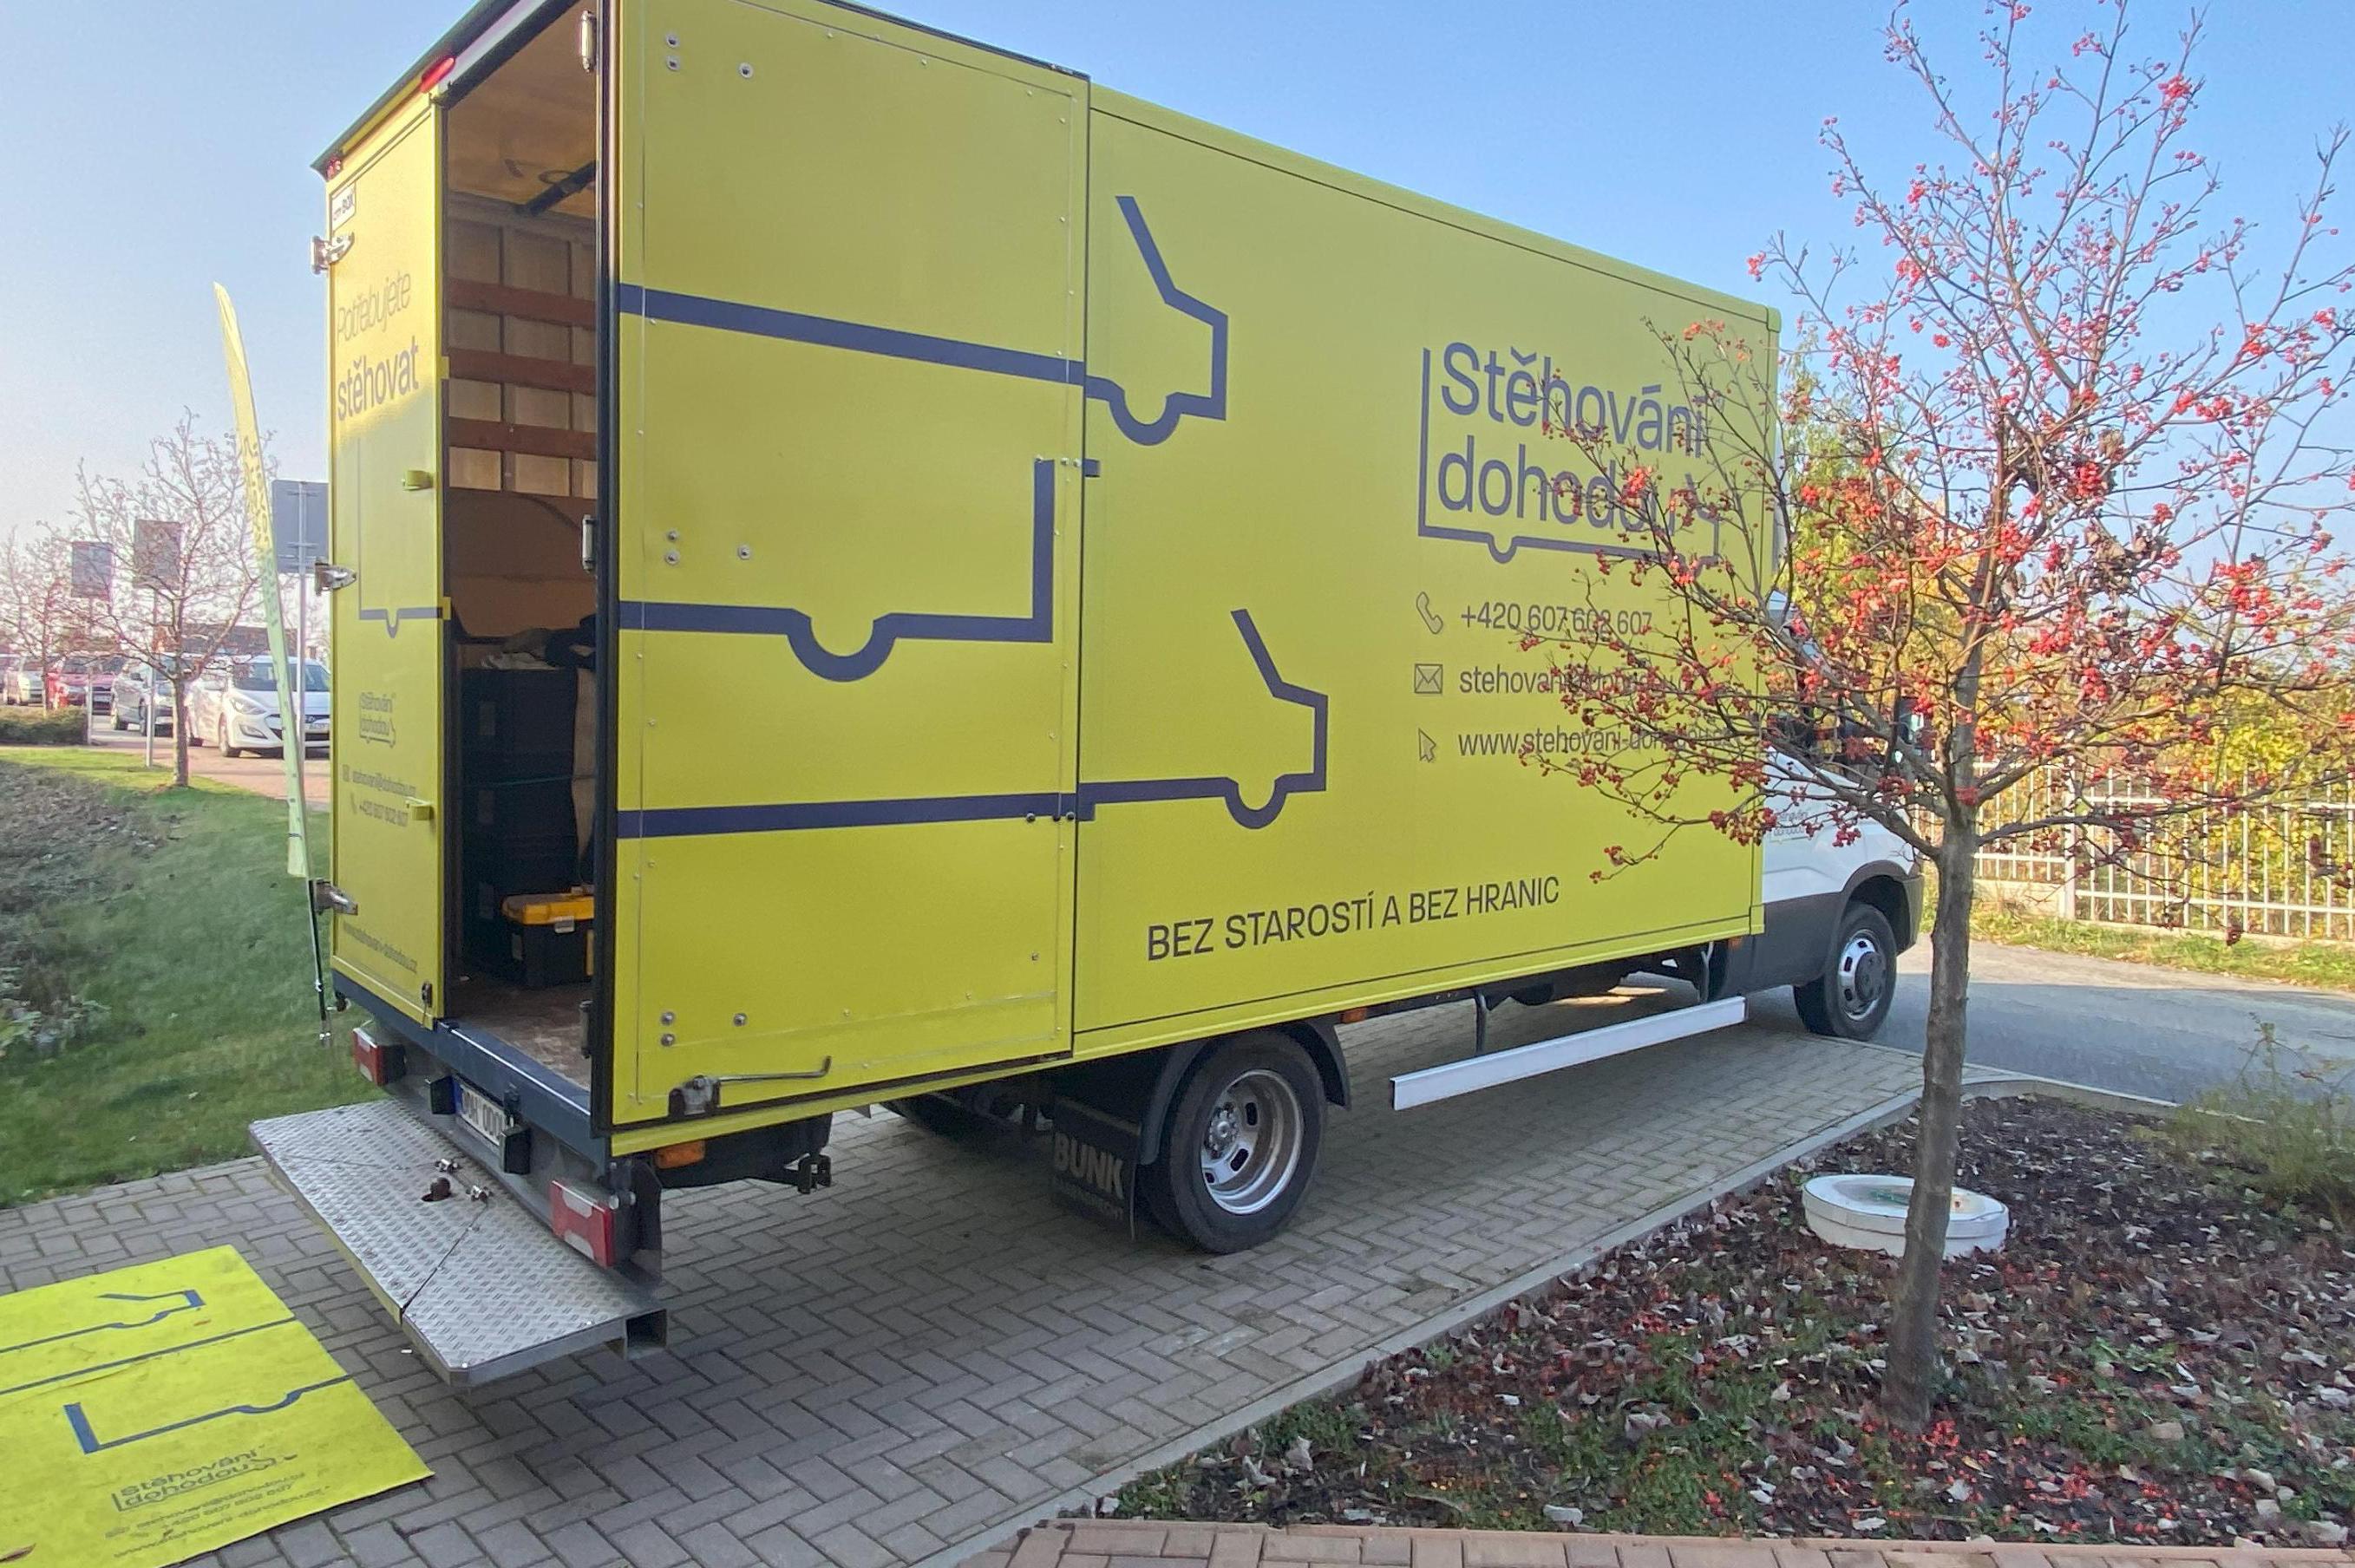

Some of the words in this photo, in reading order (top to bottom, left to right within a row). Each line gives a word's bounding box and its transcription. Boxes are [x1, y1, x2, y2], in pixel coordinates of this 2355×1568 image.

[337, 271, 411, 343] Potřebujete
[337, 335, 420, 421] stěhovat
[1442, 342, 1707, 458] Stěhování
[1462, 601, 1521, 630] +420
[1527, 604, 1567, 632] 607
[1617, 611, 1652, 635] 607
[1148, 918, 1214, 961] BEZ
[1225, 891, 1373, 950] STAROSTÍ
[1382, 896, 1400, 927] A
[1409, 888, 1459, 924] BEZ
[1467, 876, 1560, 916] HRANIC
[125, 1463, 249, 1506] dohodou
